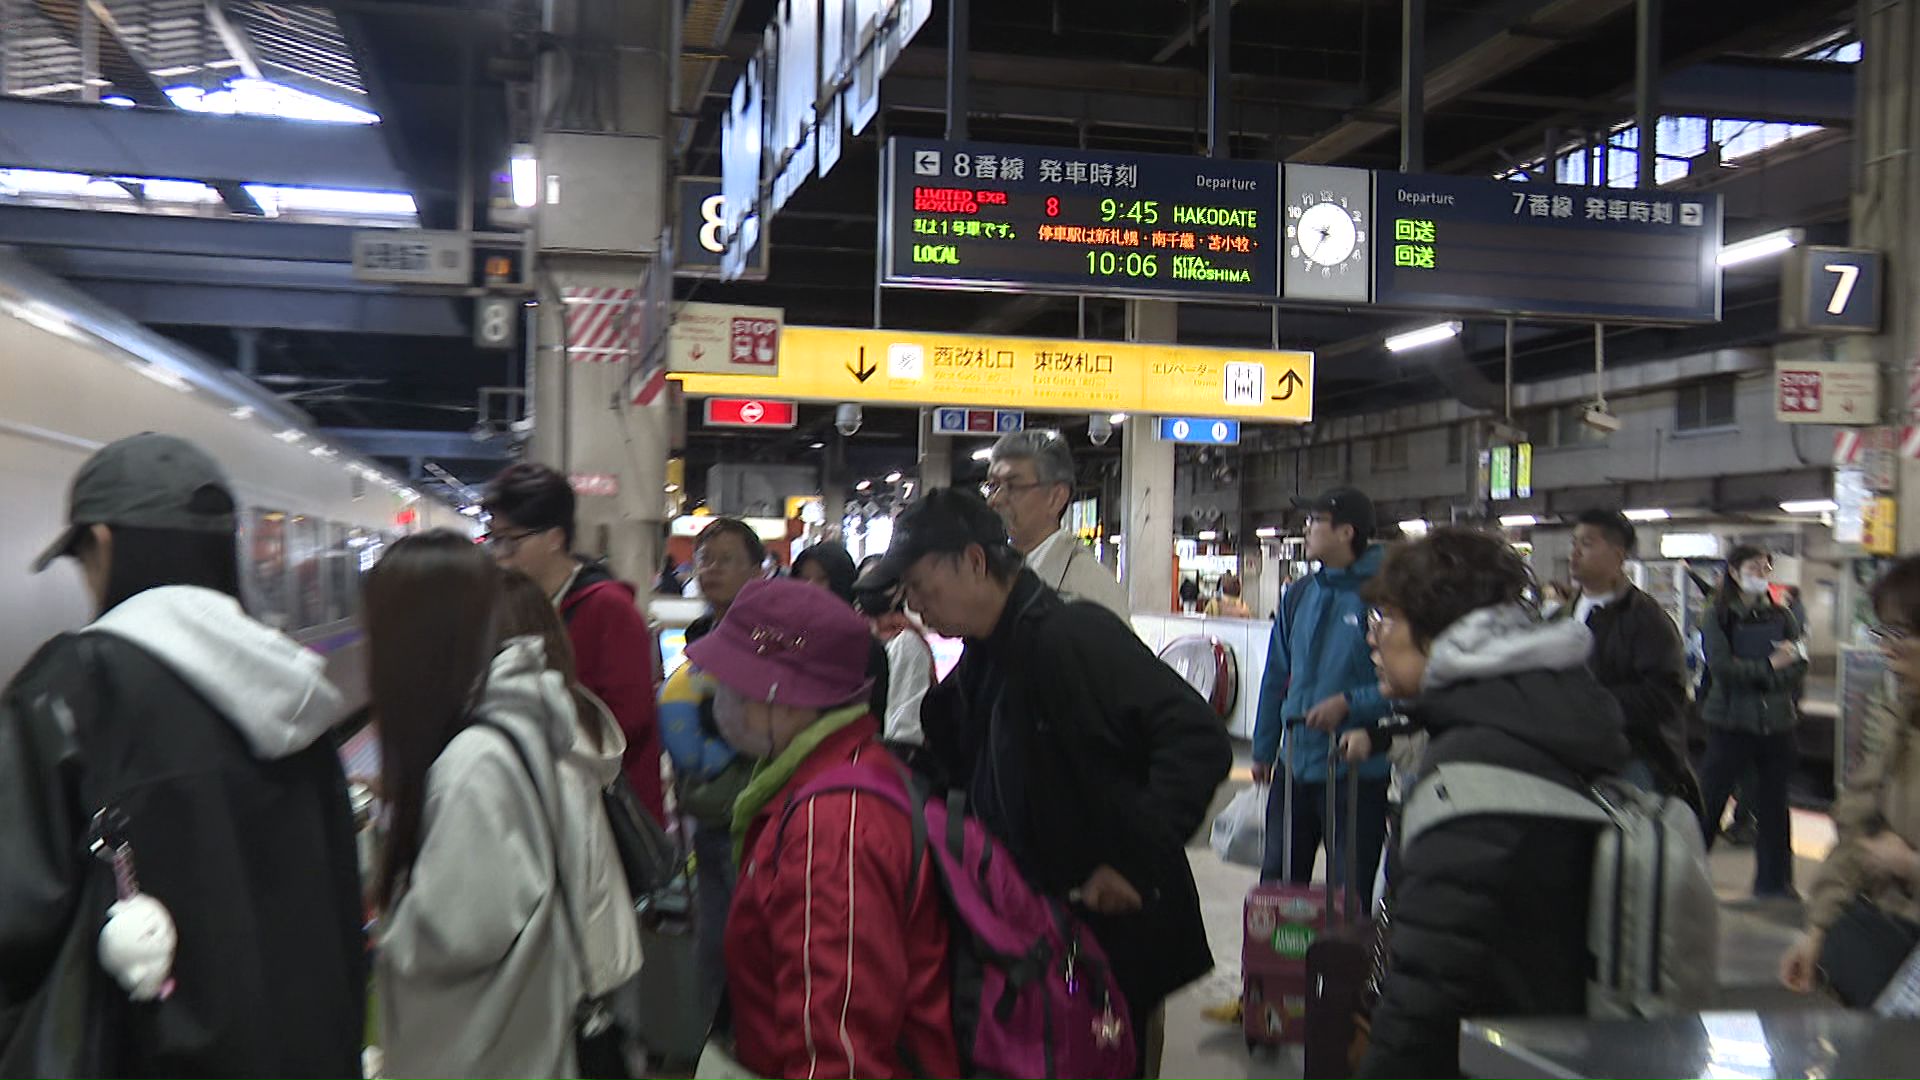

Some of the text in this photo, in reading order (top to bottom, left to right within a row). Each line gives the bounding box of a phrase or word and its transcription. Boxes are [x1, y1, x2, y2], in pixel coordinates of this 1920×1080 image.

[953, 153, 1137, 188] 8番線 発車時刻
[1196, 175, 1257, 190] Departure
[914, 187, 1007, 204] LIMITED EXP.
[914, 200, 979, 214] HOKUTO
[1046, 197, 1059, 216] 8
[1398, 189, 1455, 205] Departure
[1101, 199, 1158, 224] 9:45
[1173, 206, 1257, 228] HAKODATE
[1512, 192, 1672, 224] 7番線 発車時刻
[1395, 219, 1436, 243] 回送
[913, 245, 960, 265] LOCAL
[1086, 251, 1158, 277] 10:06
[1395, 244, 1436, 269] 回送
[1173, 267, 1250, 282] HIROSHIMA
[1824, 265, 1860, 315] 7
[482, 305, 510, 342] 8
[934, 346, 1112, 373] 西改札口 東改札口
[902, 482, 914, 499] 7
